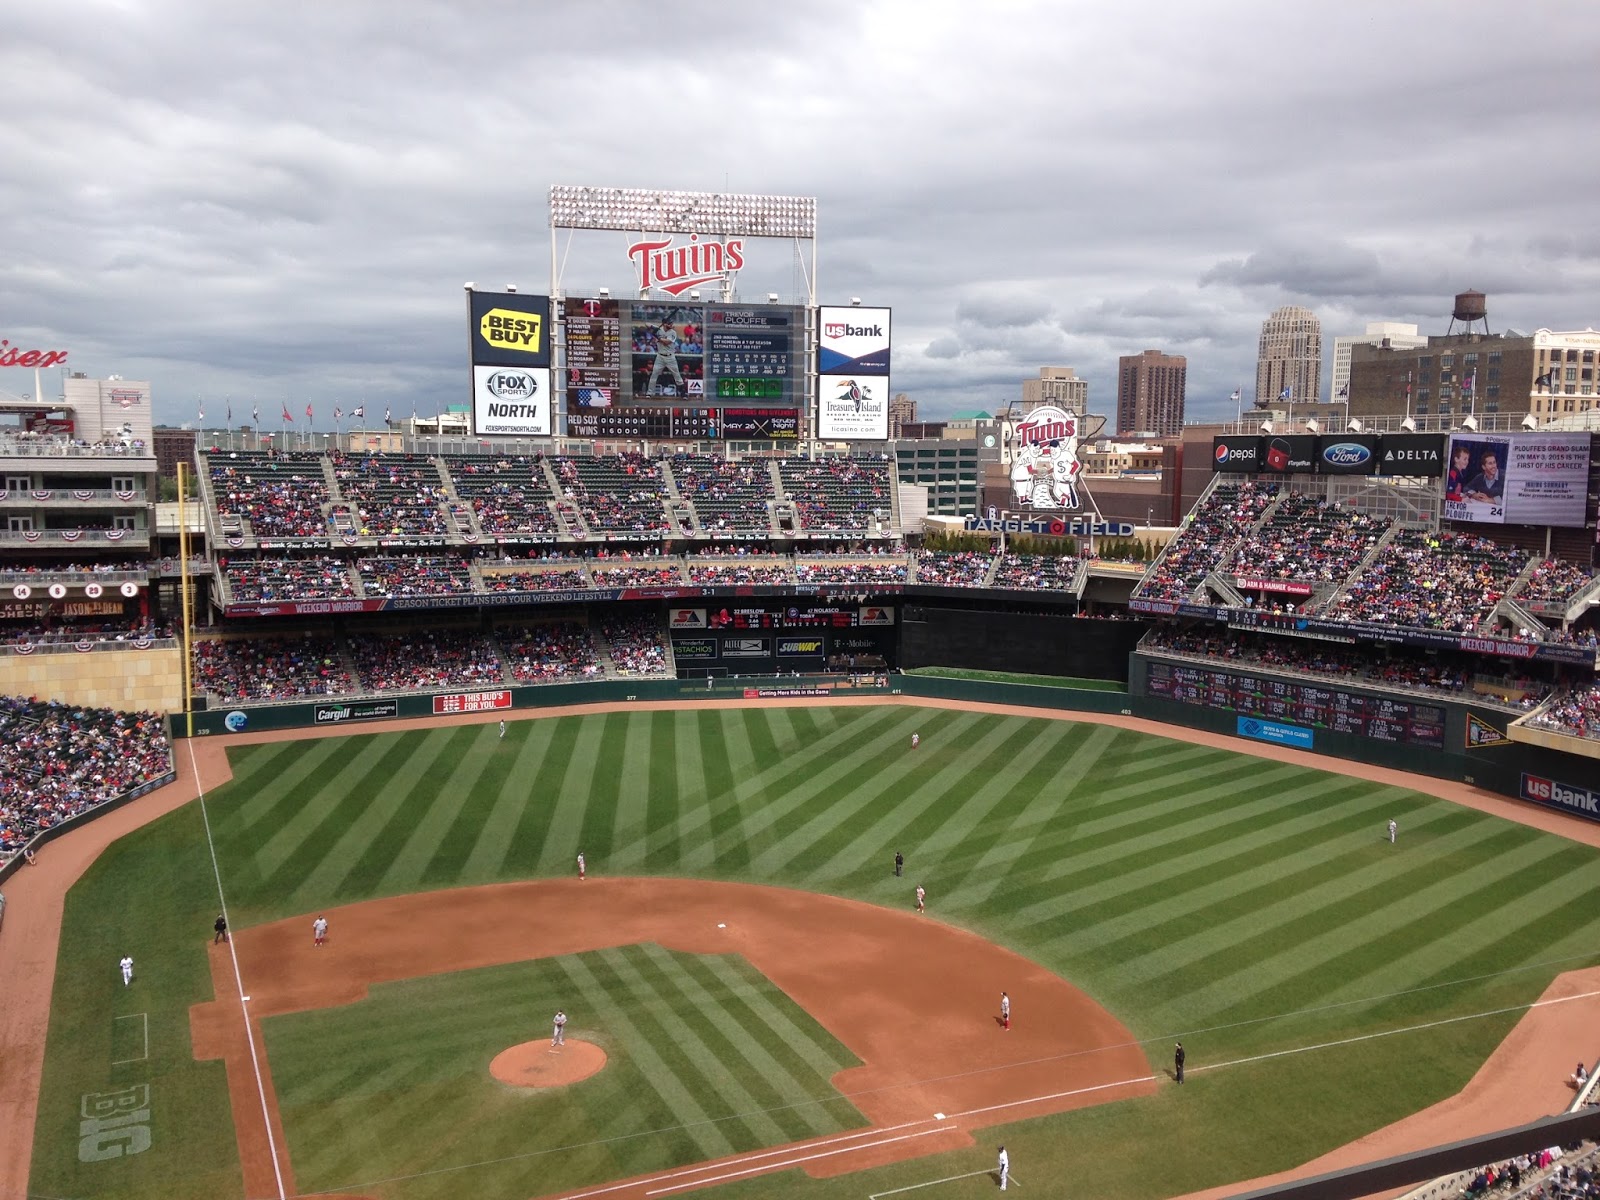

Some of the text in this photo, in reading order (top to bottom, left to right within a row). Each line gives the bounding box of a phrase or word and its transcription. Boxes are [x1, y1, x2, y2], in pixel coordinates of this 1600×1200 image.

[628, 233, 746, 292] Twins
[489, 315, 539, 333] BEST
[826, 323, 882, 337] usbank
[490, 328, 534, 345] BUY
[497, 375, 527, 390] FOX
[488, 404, 537, 418] NORTH
[827, 401, 882, 412] Treasure Island
[568, 415, 583, 424] RED
[584, 415, 598, 425] SOX
[485, 425, 542, 433] FOXSPORTSNORTH.COM
[574, 426, 598, 435] TWINS
[1015, 417, 1076, 448] Twins
[1229, 448, 1256, 461] pepsi
[1332, 447, 1361, 463] Ford
[1398, 450, 1438, 461] DELTA
[1447, 501, 1467, 511] TREVOR
[1446, 510, 1474, 521] PLOUFFE
[1490, 507, 1503, 517] 24
[965, 518, 1135, 537] TARGET FIELD
[18, 588, 27, 596] 14
[127, 586, 132, 594] 3
[703, 588, 715, 596] 3-1
[1264, 582, 1287, 591] HAMMER
[394, 591, 612, 609] SEASON TICKET PLANS FOR YOUR WEEKEND LIFESTYLE
[63, 603, 91, 615] JASON
[295, 601, 364, 613] WEEKEND WARRIOR
[1129, 600, 1151, 610] WEEKEND
[1152, 602, 1174, 613] WARRIOR
[1348, 625, 1386, 634] #MemorialDay
[1409, 631, 1429, 639] @Twins
[725, 640, 741, 649] ALTEC
[780, 642, 821, 652] SUBWAY
[1461, 638, 1529, 657] WEEKEND WARRIOR
[464, 693, 504, 703] THIS BUD'S
[464, 702, 479, 710] FOR
[480, 701, 497, 709] YOU.
[1394, 705, 1409, 713] 8:05
[318, 708, 351, 721] Cargill
[1480, 730, 1500, 740] Twins
[1528, 779, 1599, 813] usbank
